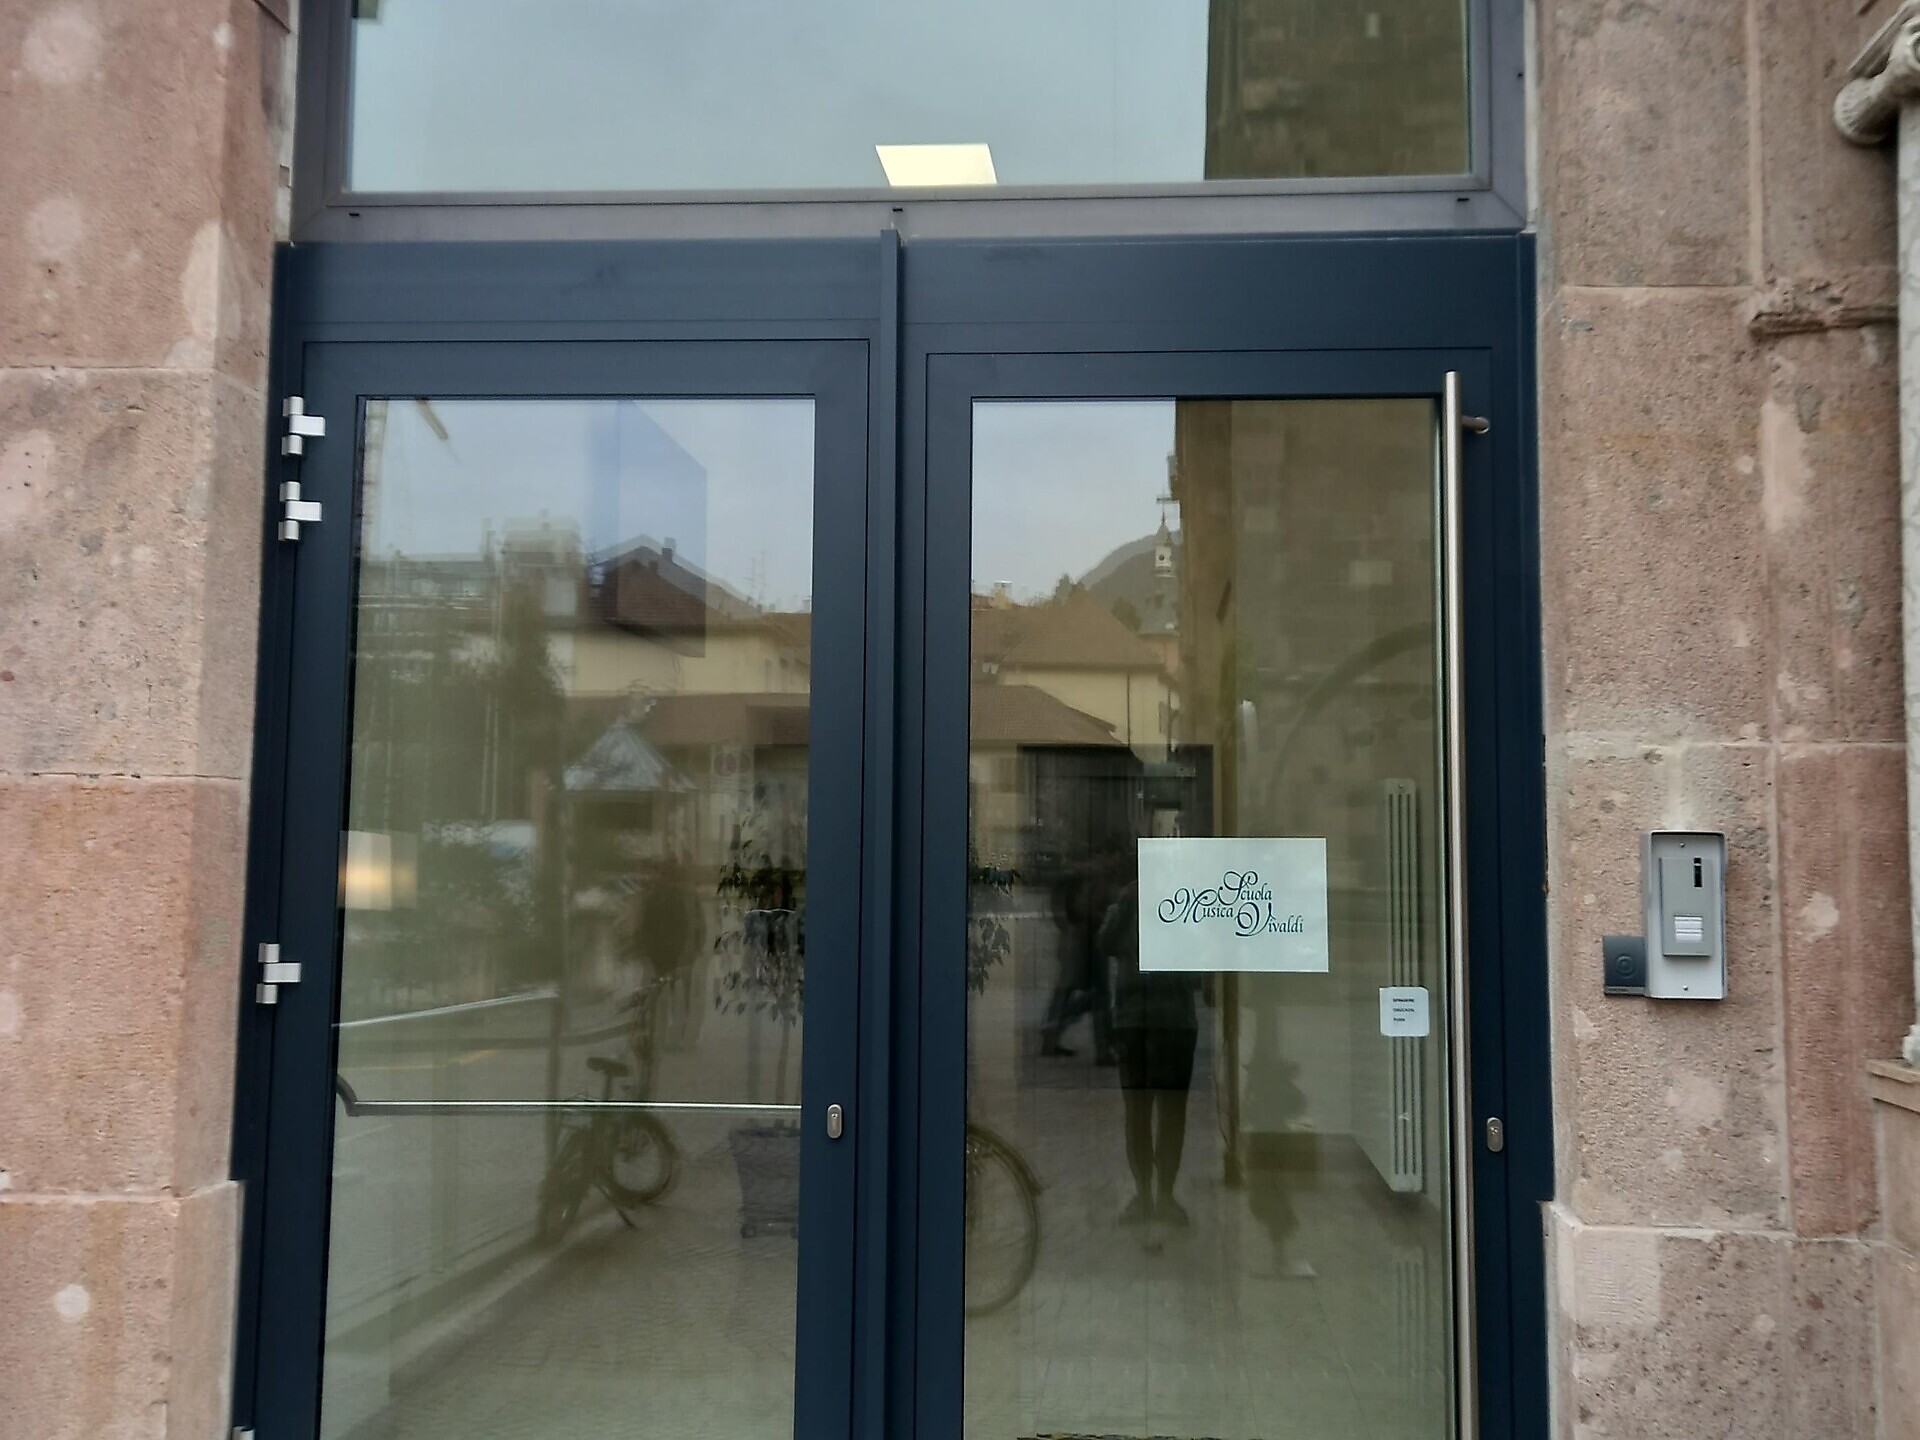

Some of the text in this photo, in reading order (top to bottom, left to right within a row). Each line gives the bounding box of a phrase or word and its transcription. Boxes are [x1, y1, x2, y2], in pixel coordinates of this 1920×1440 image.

[1158, 887, 1234, 924] Musica
[1218, 870, 1272, 906] Scuola
[1234, 901, 1304, 937] Vivaldi
